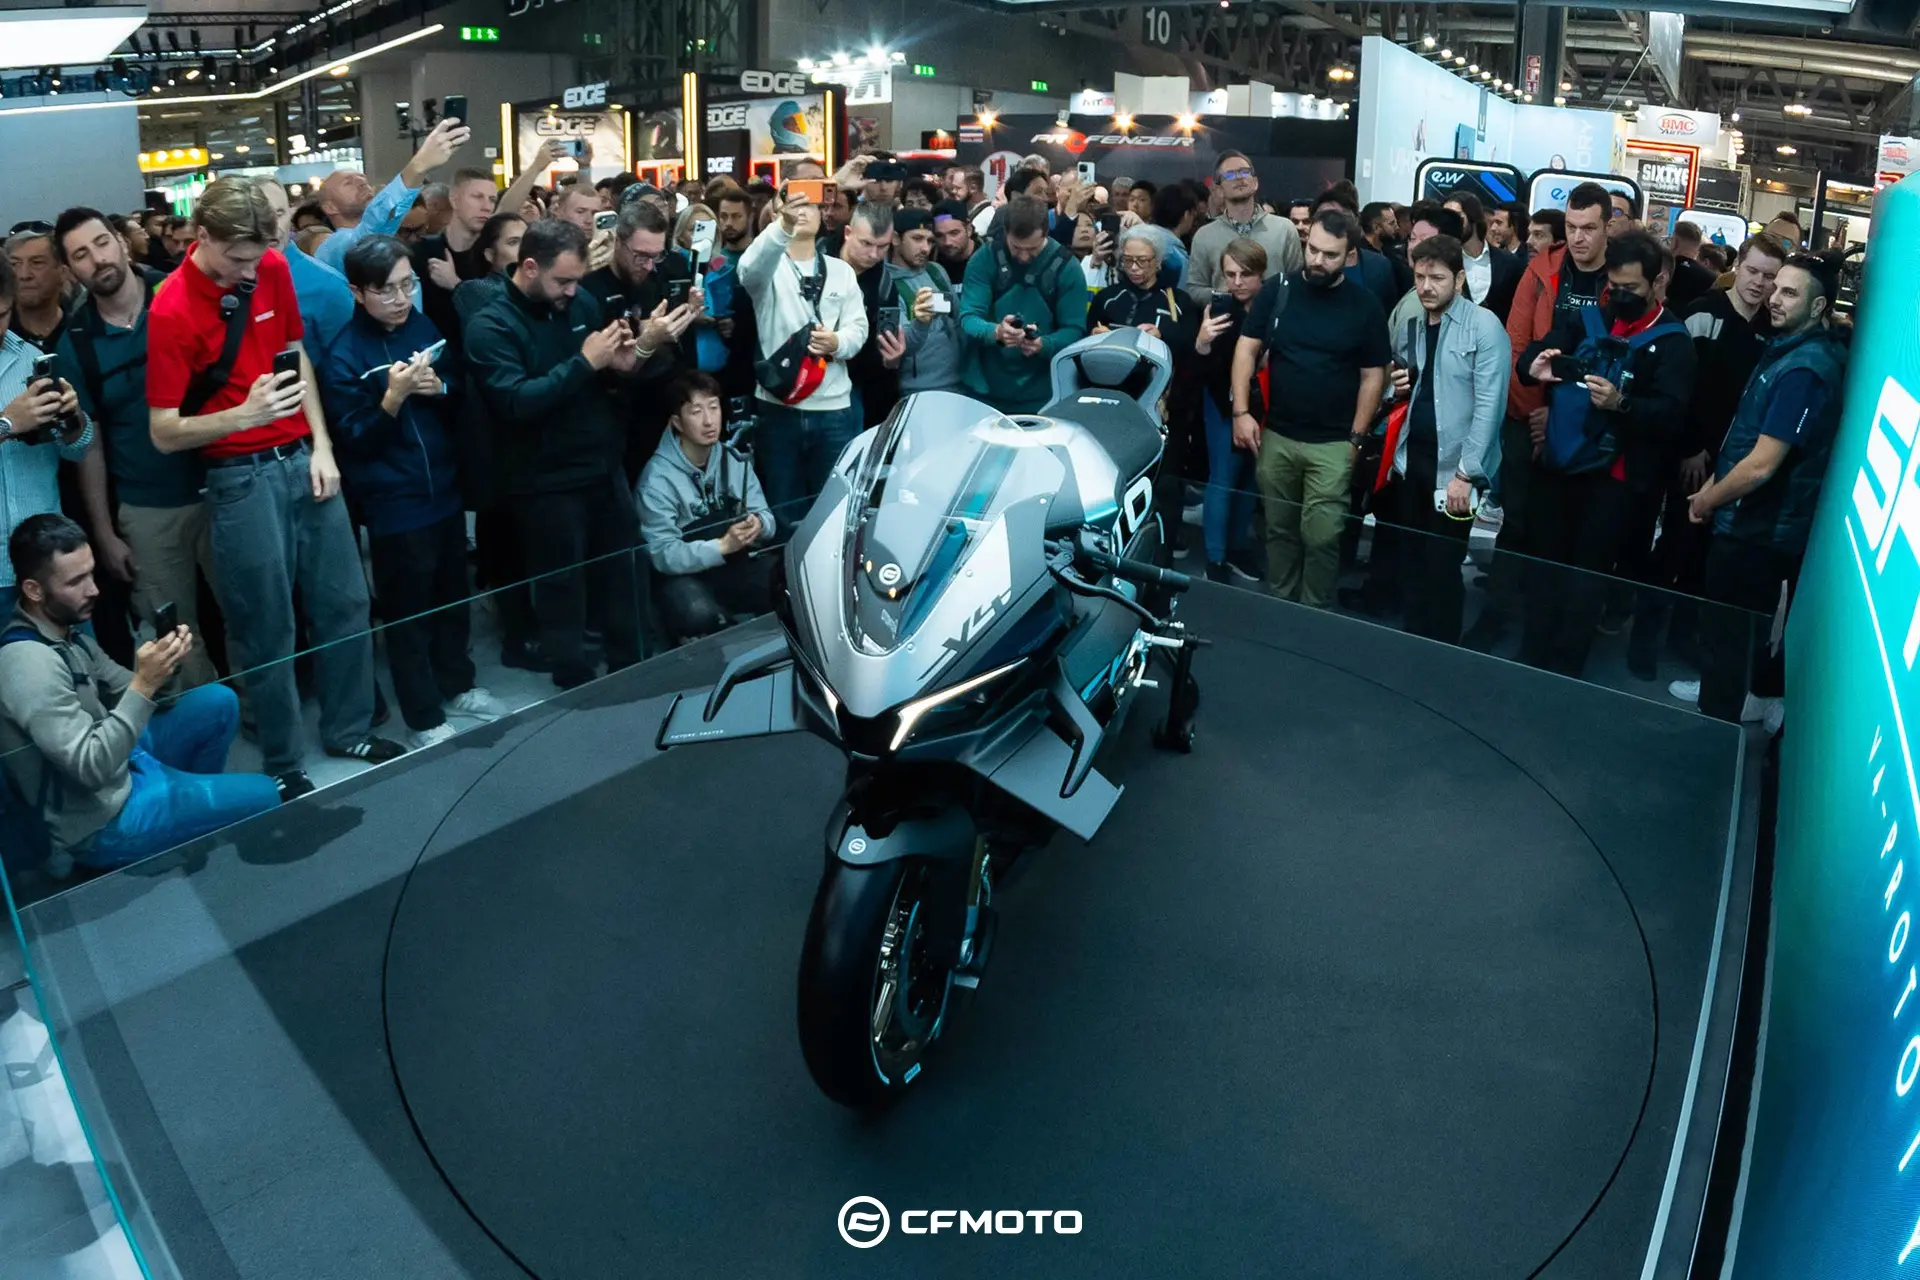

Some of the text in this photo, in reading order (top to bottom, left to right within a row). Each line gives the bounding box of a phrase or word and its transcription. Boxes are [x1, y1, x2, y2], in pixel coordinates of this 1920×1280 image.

[1146, 6, 1171, 45] 10
[741, 70, 805, 94] EDGE
[564, 82, 606, 109] EDGE
[535, 115, 597, 136] EDGE
[1661, 118, 1695, 132] BMC
